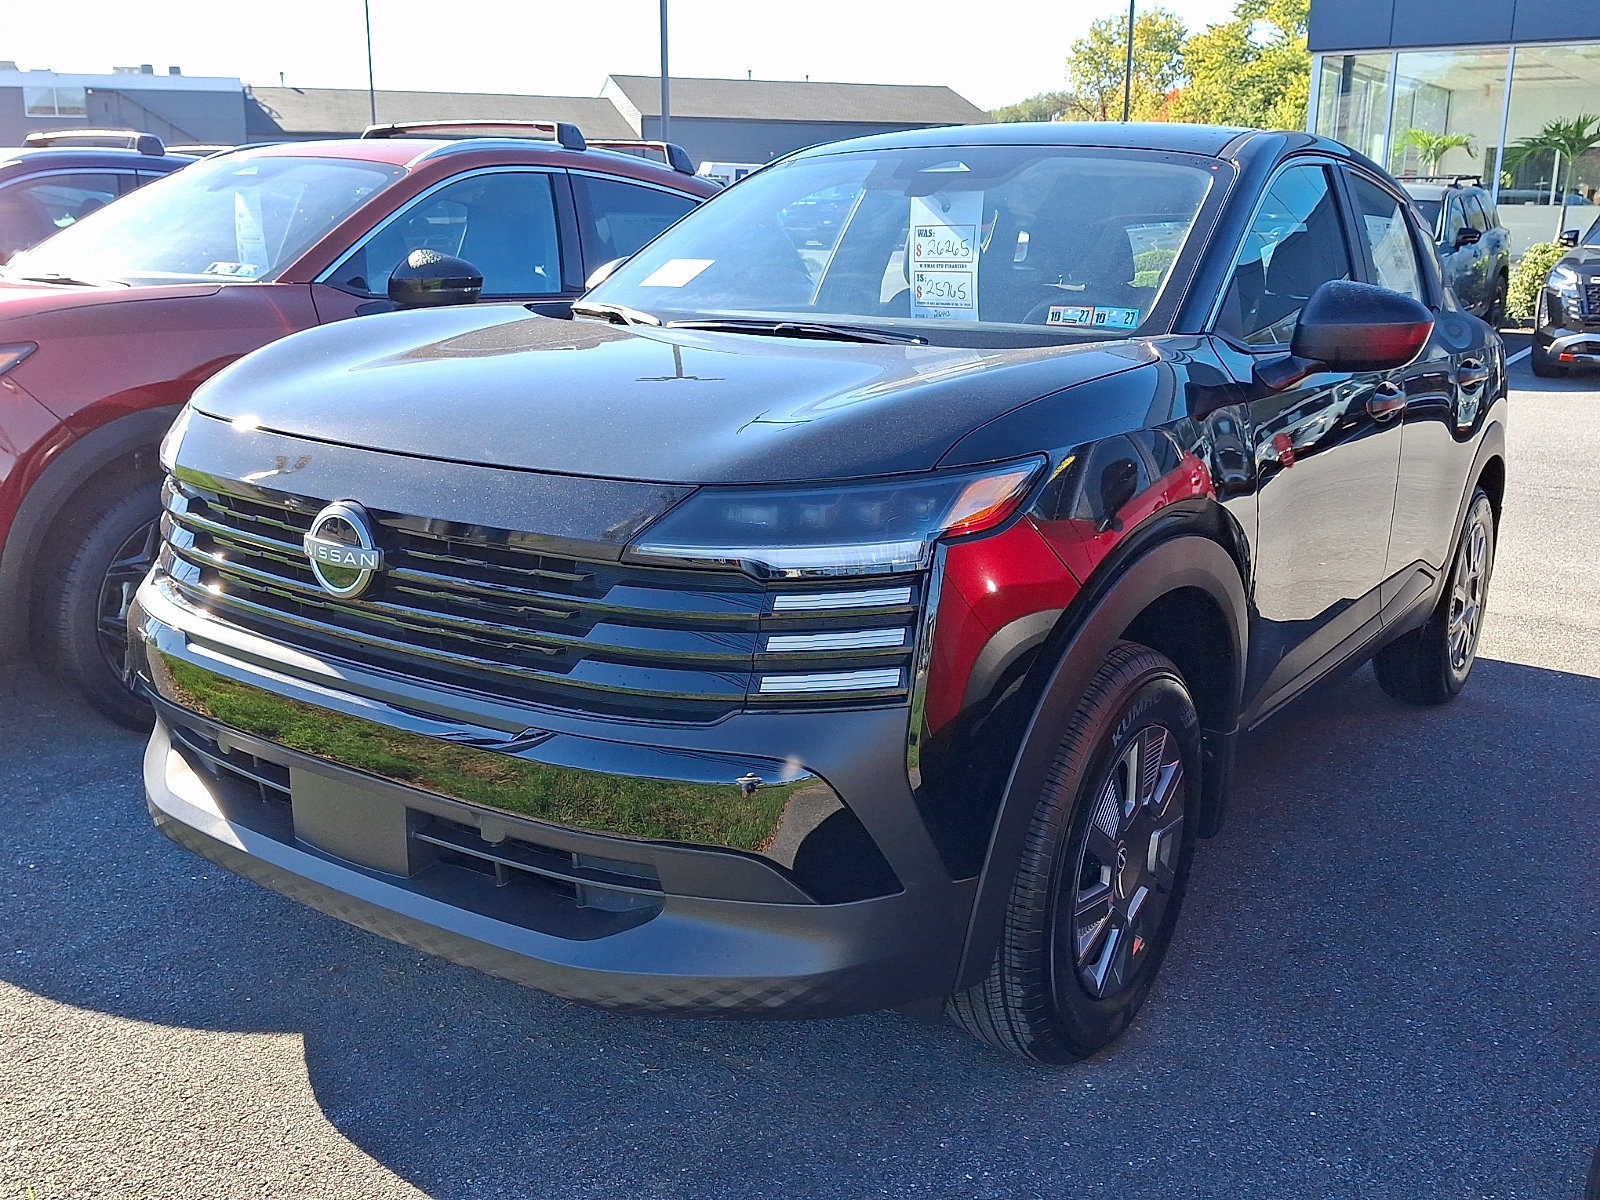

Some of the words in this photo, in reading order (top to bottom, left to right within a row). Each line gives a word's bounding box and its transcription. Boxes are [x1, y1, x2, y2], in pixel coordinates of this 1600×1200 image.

[917, 229, 935, 238] WAS:
[916, 243, 922, 257] $
[927, 239, 970, 257] 26265
[916, 274, 927, 282] IS:
[916, 285, 922, 299] $
[1050, 311, 1061, 321] 10
[1078, 310, 1089, 323] 27
[1095, 312, 1106, 323] 10
[1124, 312, 1135, 325] 27
[303, 540, 375, 566] NISSAN
